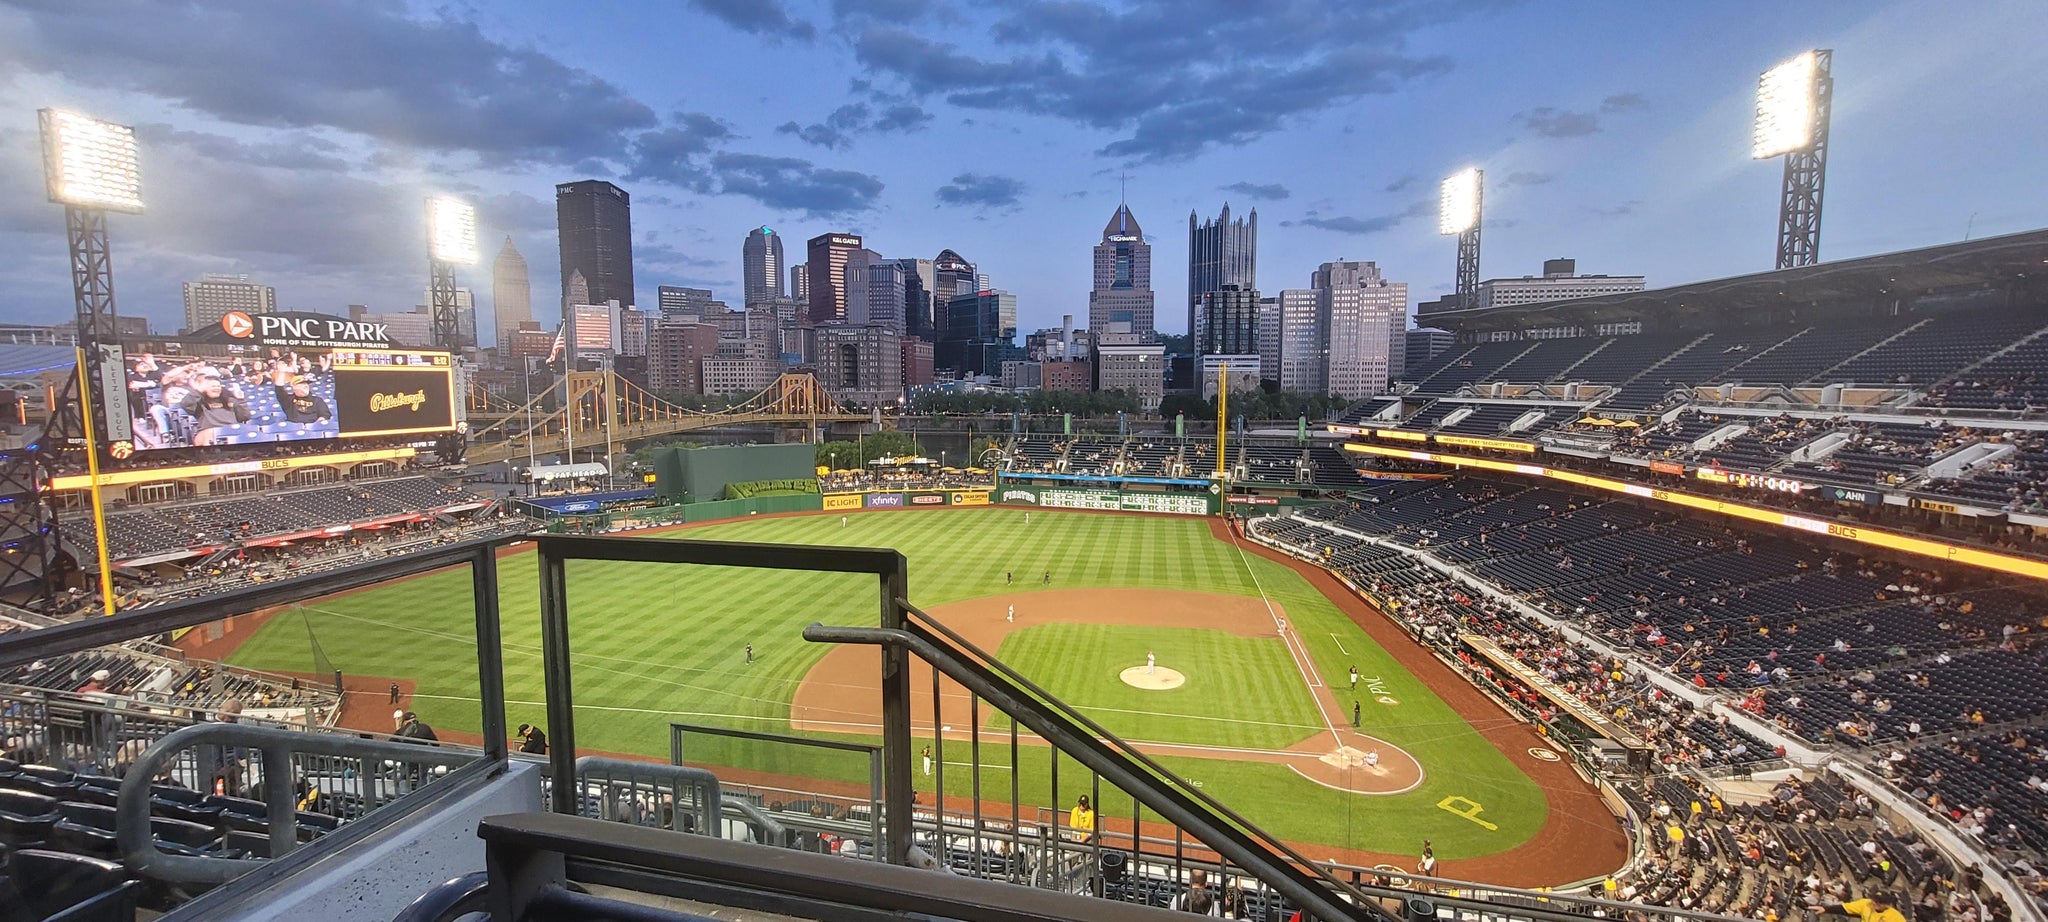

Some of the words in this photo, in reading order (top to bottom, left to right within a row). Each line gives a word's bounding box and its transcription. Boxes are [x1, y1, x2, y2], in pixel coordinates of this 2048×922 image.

[258, 316, 321, 339] PNC
[325, 320, 390, 342] PARK
[318, 340, 361, 348] PITTSBURGH
[370, 390, 426, 412] Pittsburgh
[261, 459, 289, 469] BUCS
[572, 470, 604, 478] HEAD'S
[1768, 477, 1776, 489] 0
[1779, 479, 1787, 491] 0
[1790, 481, 1799, 493] 0
[872, 495, 899, 506] xfinity
[1003, 490, 1036, 504] PIRATES
[1651, 490, 1669, 500] BUCS
[1845, 491, 1866, 502] AHN
[837, 498, 859, 507] LIGHT
[1827, 524, 1857, 539] BUCS
[1361, 674, 1392, 694] PNC
[1436, 795, 1499, 832] P
